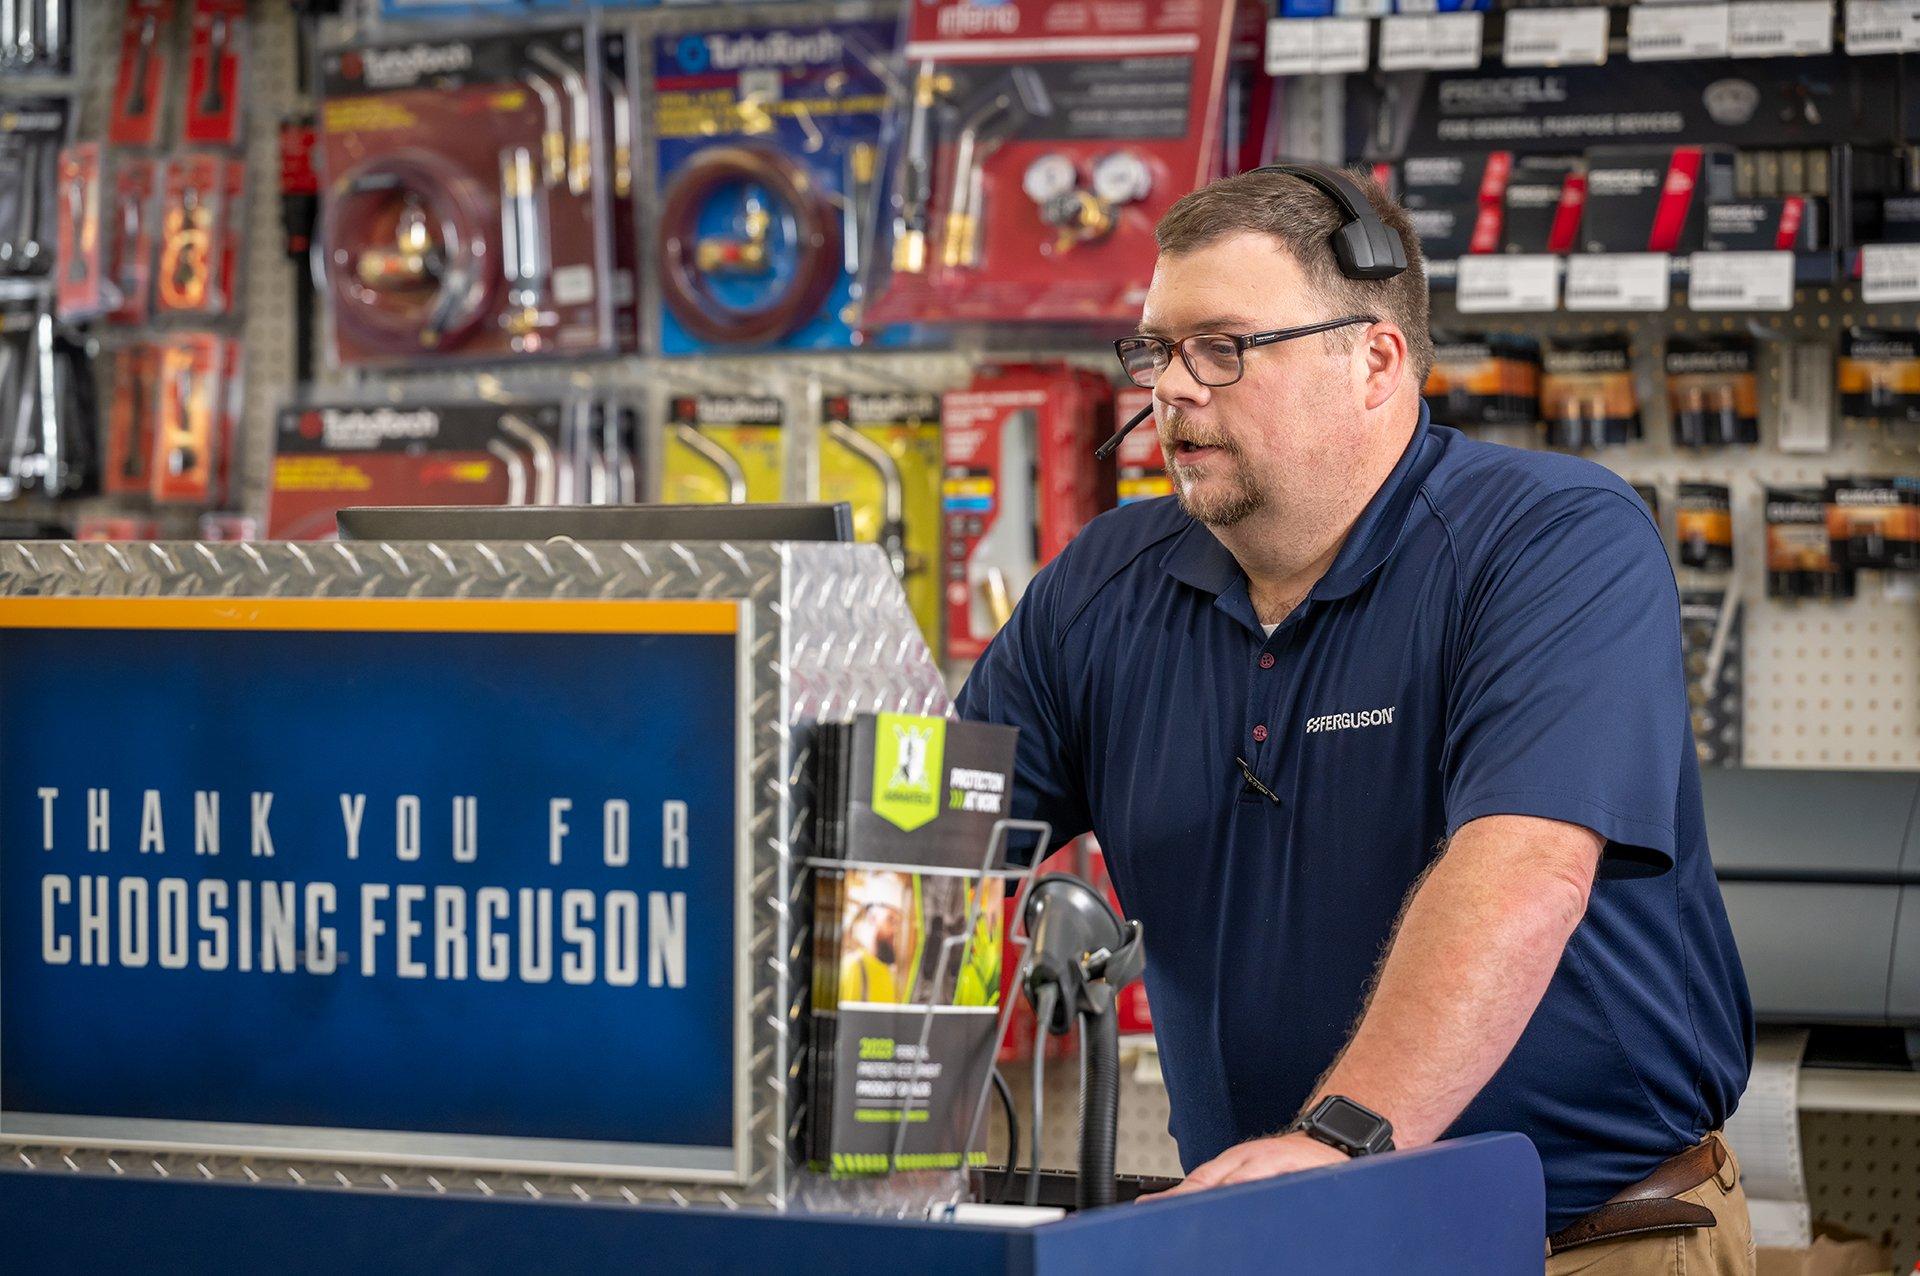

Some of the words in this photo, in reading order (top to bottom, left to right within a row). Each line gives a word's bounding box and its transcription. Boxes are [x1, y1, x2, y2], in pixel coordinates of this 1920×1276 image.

[1439, 76, 1567, 102] PROCELL
[1437, 118, 1470, 141] FOR
[1471, 116, 1541, 140] GENERAL
[1542, 113, 1614, 137] PURPOSE
[1615, 111, 1685, 135] DEVICES
[1320, 707, 1394, 732] FERGUSON
[37, 786, 276, 858] THANK
[339, 793, 478, 864] YOU
[549, 797, 689, 869] FOR
[41, 873, 337, 975] CHOOSING
[360, 882, 688, 990] FERGUSON
